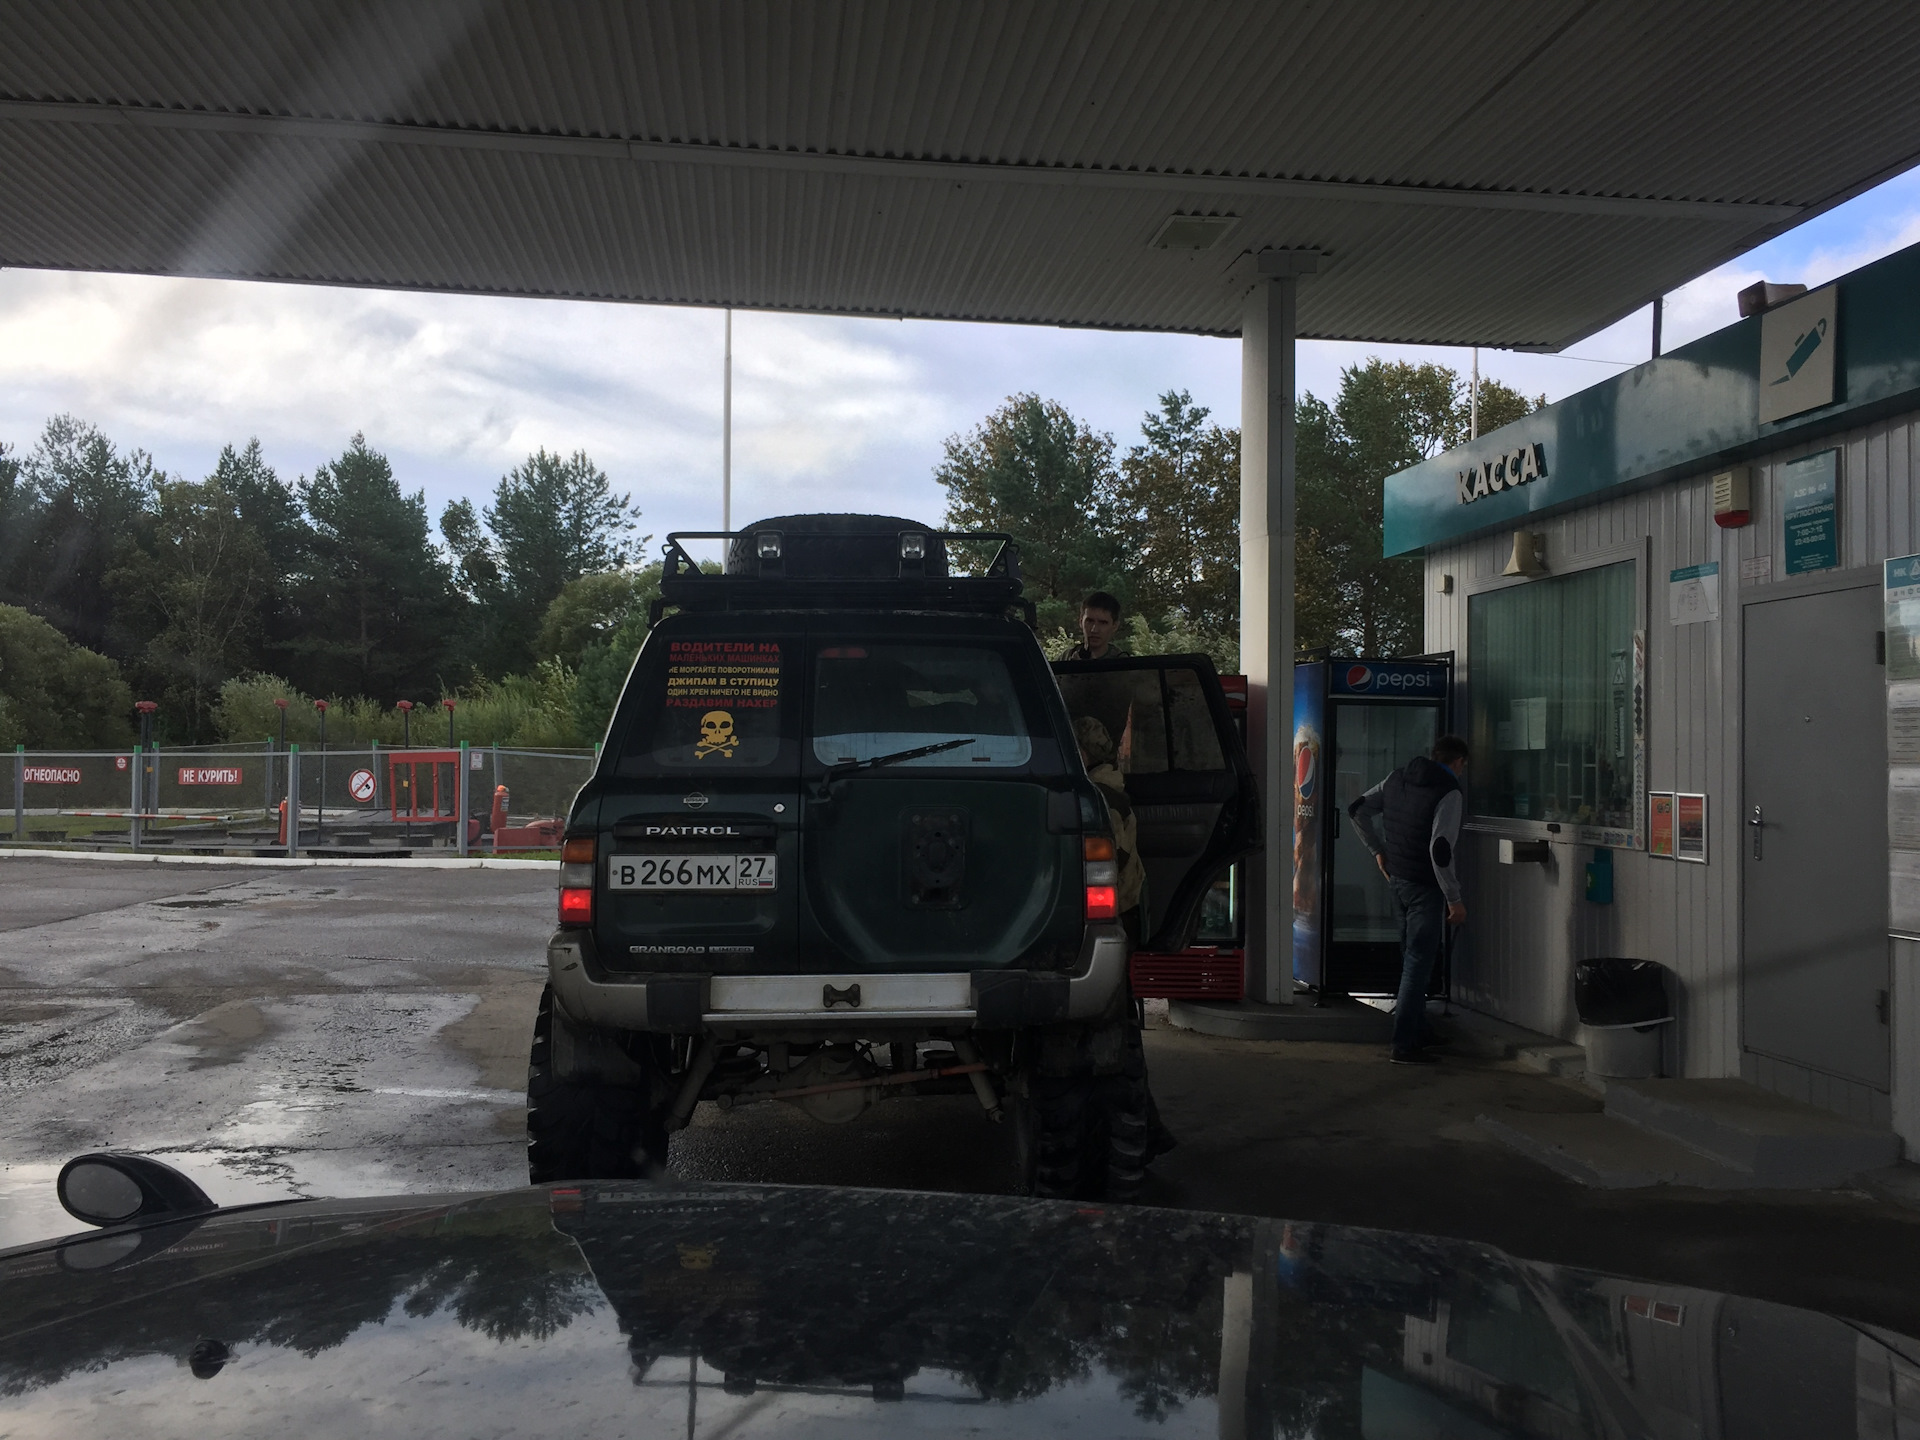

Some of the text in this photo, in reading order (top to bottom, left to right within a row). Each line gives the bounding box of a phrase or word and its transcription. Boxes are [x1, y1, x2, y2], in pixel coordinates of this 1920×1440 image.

[1456, 442, 1543, 505] КАССА
[670, 642, 780, 653] ВОДИТЕЛИ НА
[669, 654, 779, 662] МАЛЕНЬКИХ МАШИНКАХ
[679, 665, 716, 673] МОРГАЙТЕ
[717, 666, 780, 674] ПОВОРОТНИКАМИ
[667, 678, 779, 687] ДЖИПАМ В СТУПИЦУ
[1376, 671, 1430, 690] pepsi
[752, 689, 779, 697] ВИДНО
[666, 698, 778, 708] РАЗДАВИМ НАХЕР
[24, 768, 80, 783] ОГНЕОПАСНО
[183, 769, 238, 783] НЕ КУРИТЬ!
[646, 826, 740, 836] PATROL
[739, 858, 766, 878] 27
[738, 878, 758, 886] RUS
[629, 945, 705, 953] GRANROAD
